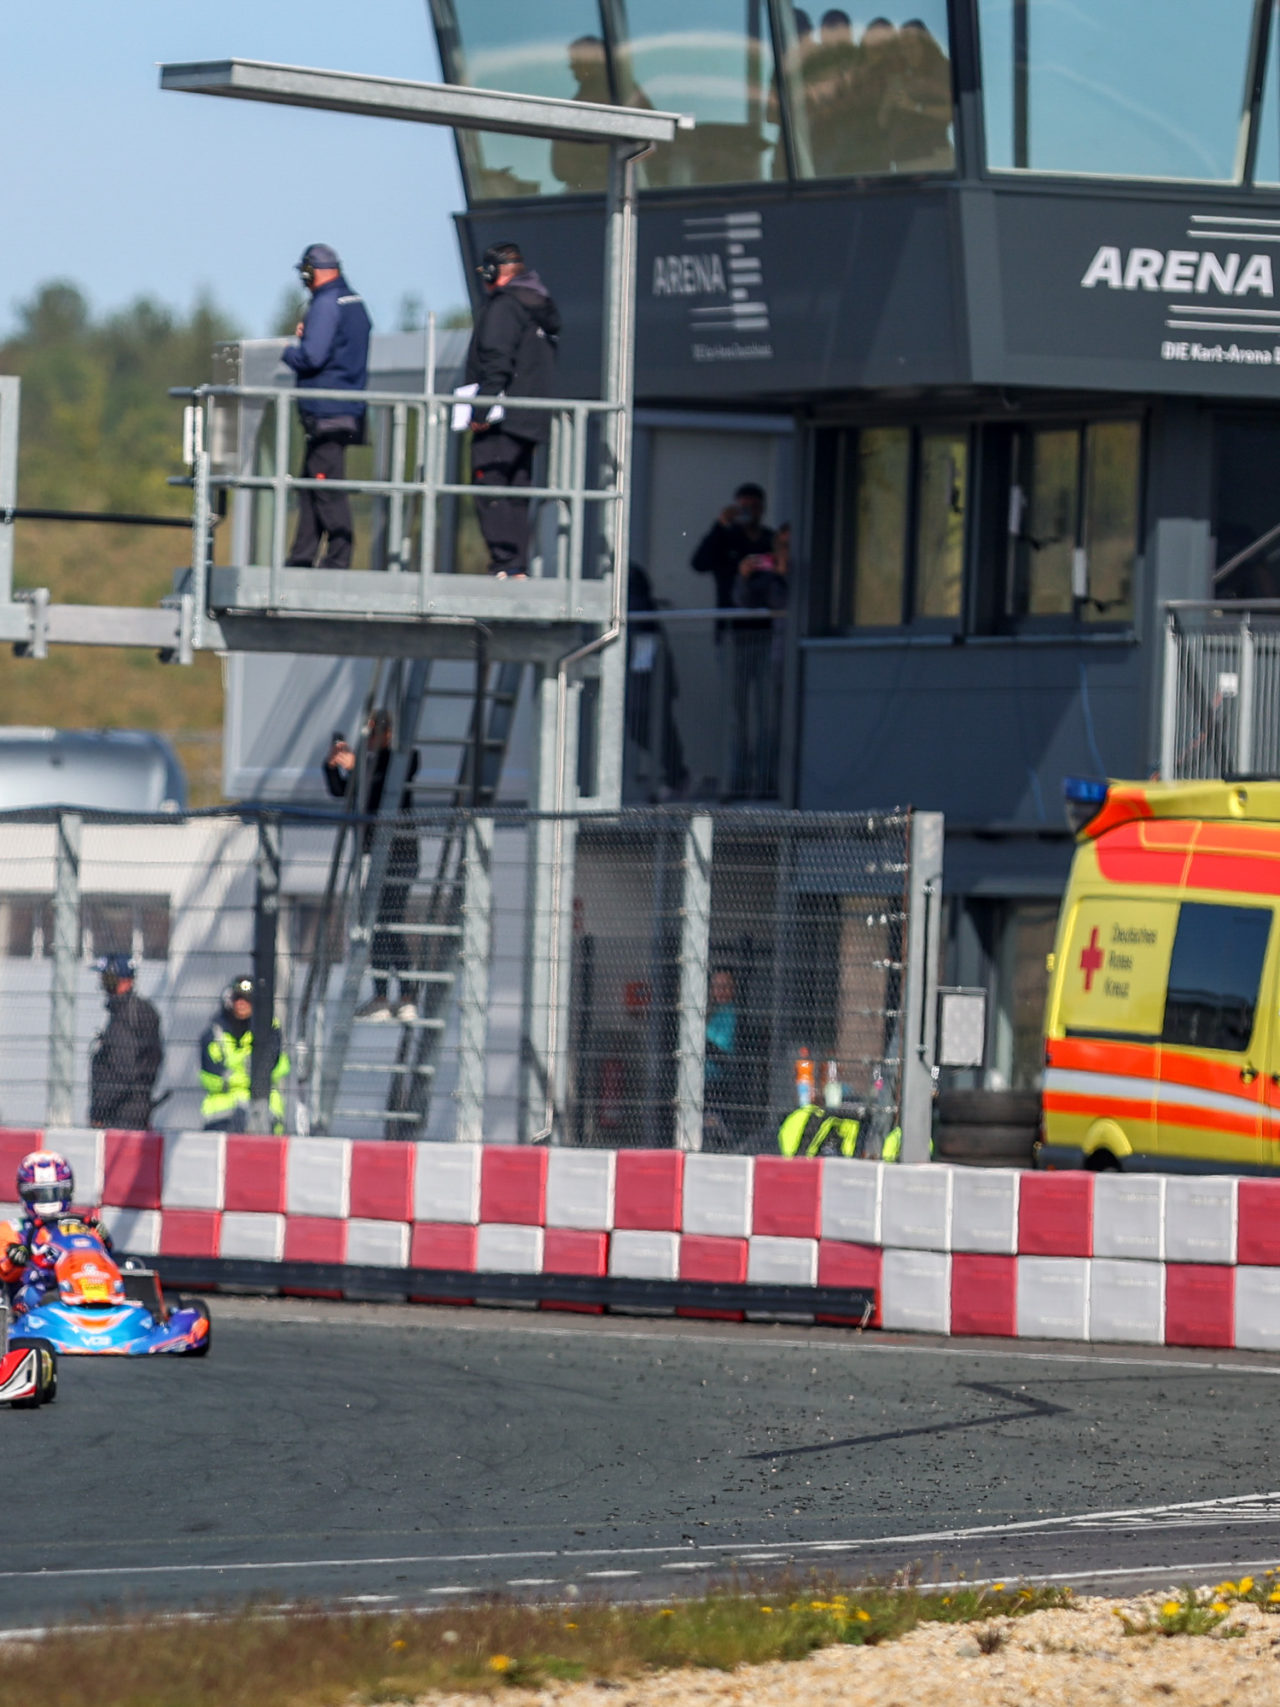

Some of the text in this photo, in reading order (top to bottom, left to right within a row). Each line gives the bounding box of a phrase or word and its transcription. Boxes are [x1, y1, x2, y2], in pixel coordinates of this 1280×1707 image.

[653, 254, 726, 295] ARENA
[1081, 246, 1274, 297] ARENA
[1162, 341, 1189, 360] DIE
